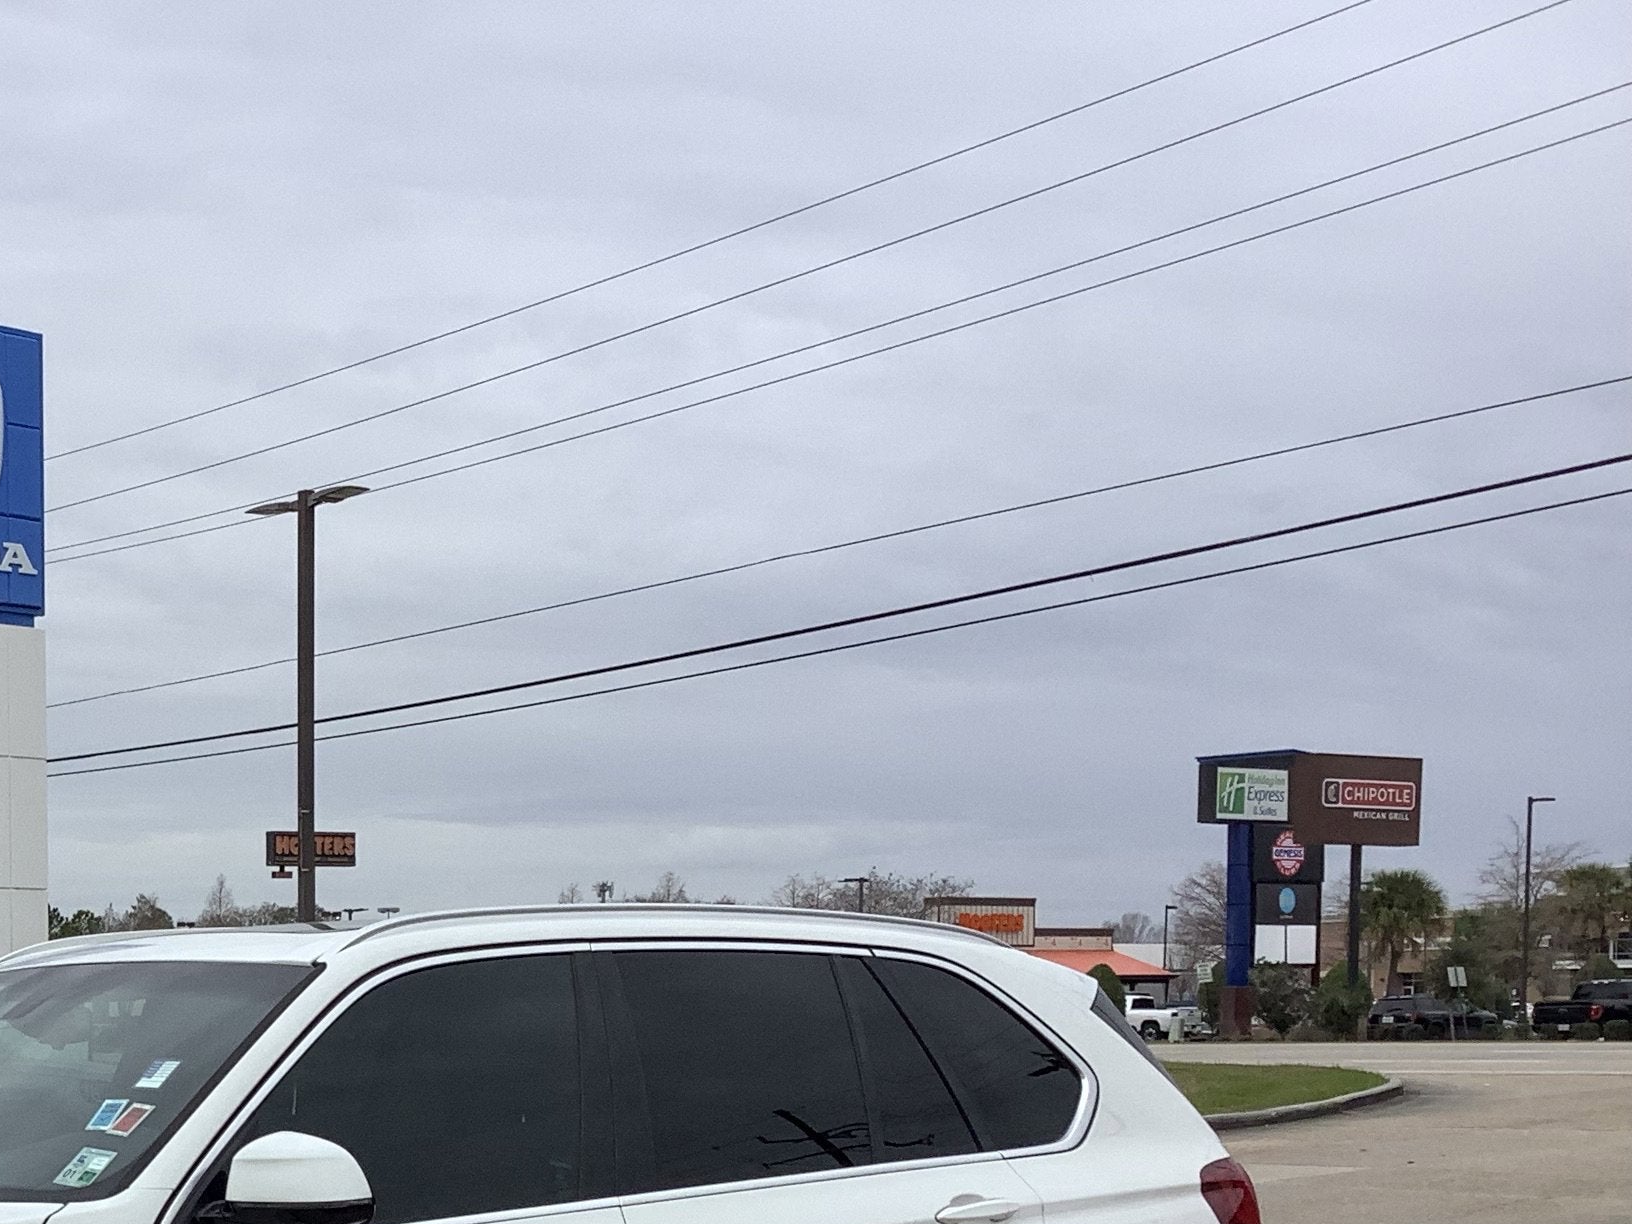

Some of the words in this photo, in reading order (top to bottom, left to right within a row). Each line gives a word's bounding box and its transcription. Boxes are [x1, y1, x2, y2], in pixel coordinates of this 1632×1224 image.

[1247, 785, 1286, 804] Express
[1344, 786, 1411, 803] CHIPOTLE
[1353, 810, 1387, 820] MEXICAN
[1388, 811, 1410, 821] GRILL
[275, 835, 355, 856] HOTERS
[1274, 848, 1303, 858] GENESIS
